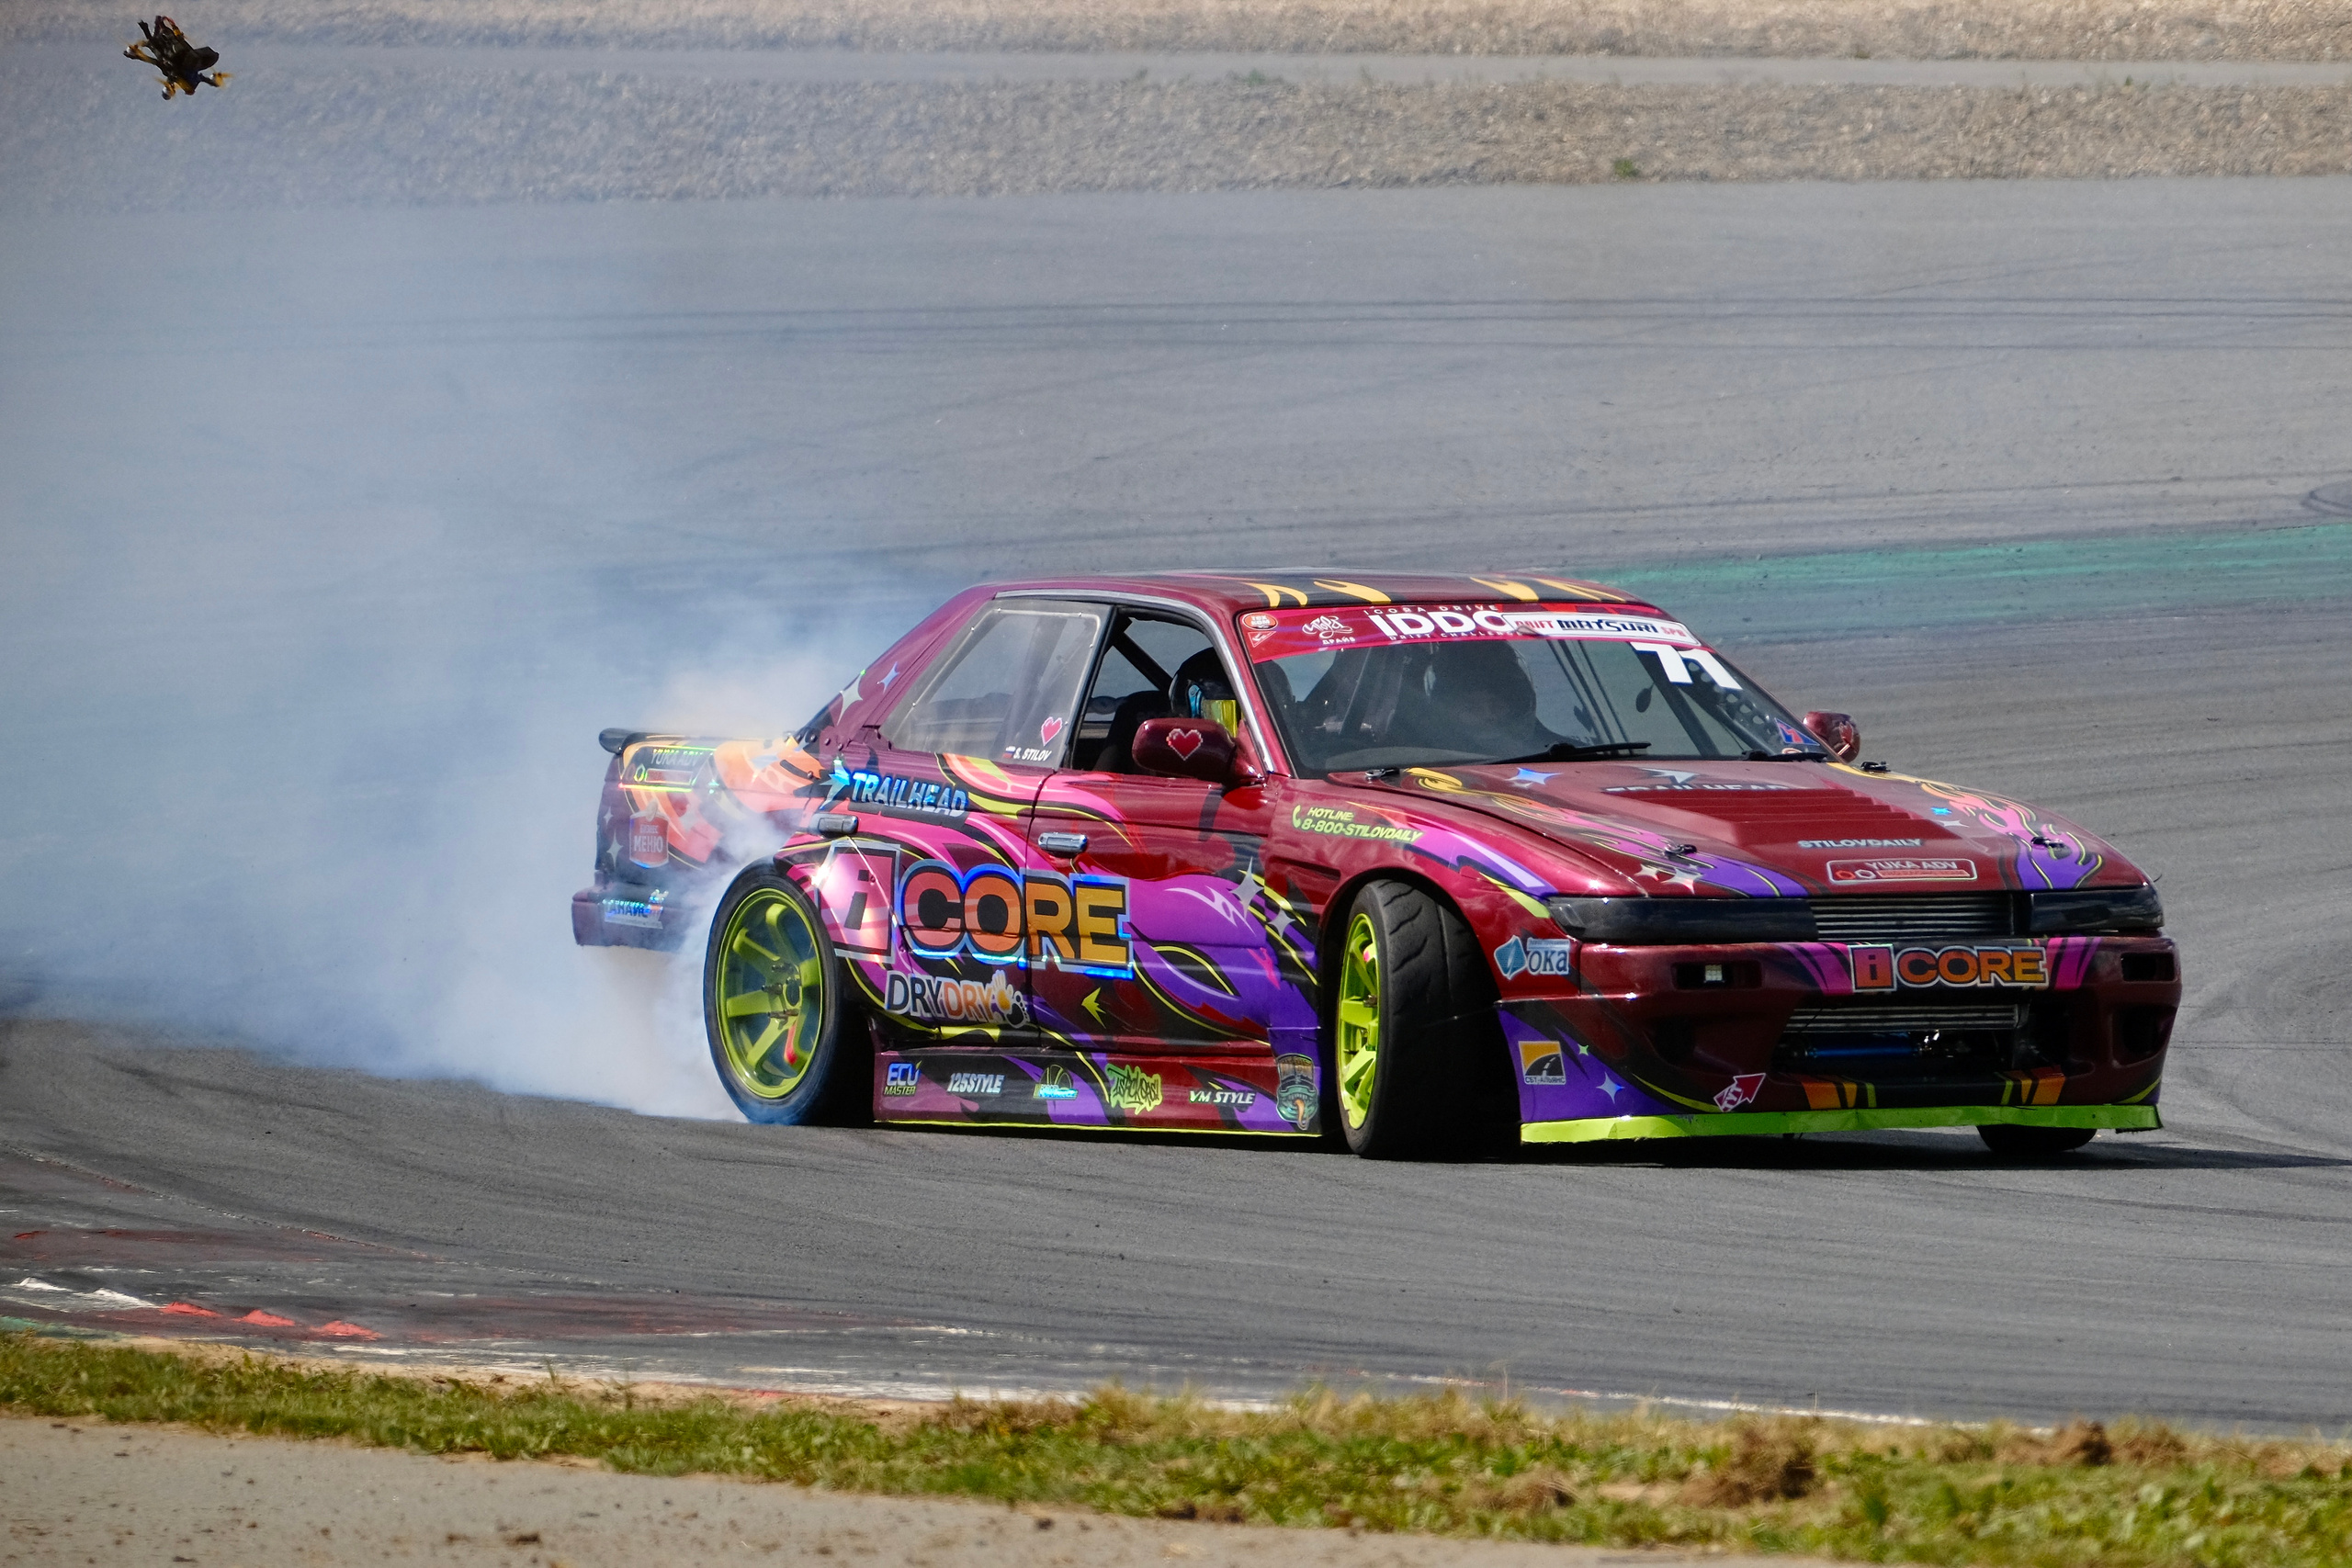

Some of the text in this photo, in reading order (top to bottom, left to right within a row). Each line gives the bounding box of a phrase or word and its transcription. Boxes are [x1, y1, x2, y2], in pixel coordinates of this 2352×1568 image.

[1363, 607, 1427, 615] IGORA
[1556, 619, 1659, 633] MATSURI
[1389, 633, 1431, 641] DRIFT
[1022, 748, 1052, 761] STILOV
[851, 772, 969, 818] TRAILHEAD
[1301, 818, 1424, 842] 8-800-STILOVDAILY
[633, 835, 663, 853] МЕНЮ
[1797, 839, 1923, 849] STILOVDAILY
[1865, 861, 1959, 870] YUKA ADV
[887, 1062, 921, 1086] ECU
[946, 1072, 1005, 1093] 125STYLE
[884, 1085, 917, 1096] MASTER
[1189, 1090, 1256, 1104] VM STYLE
